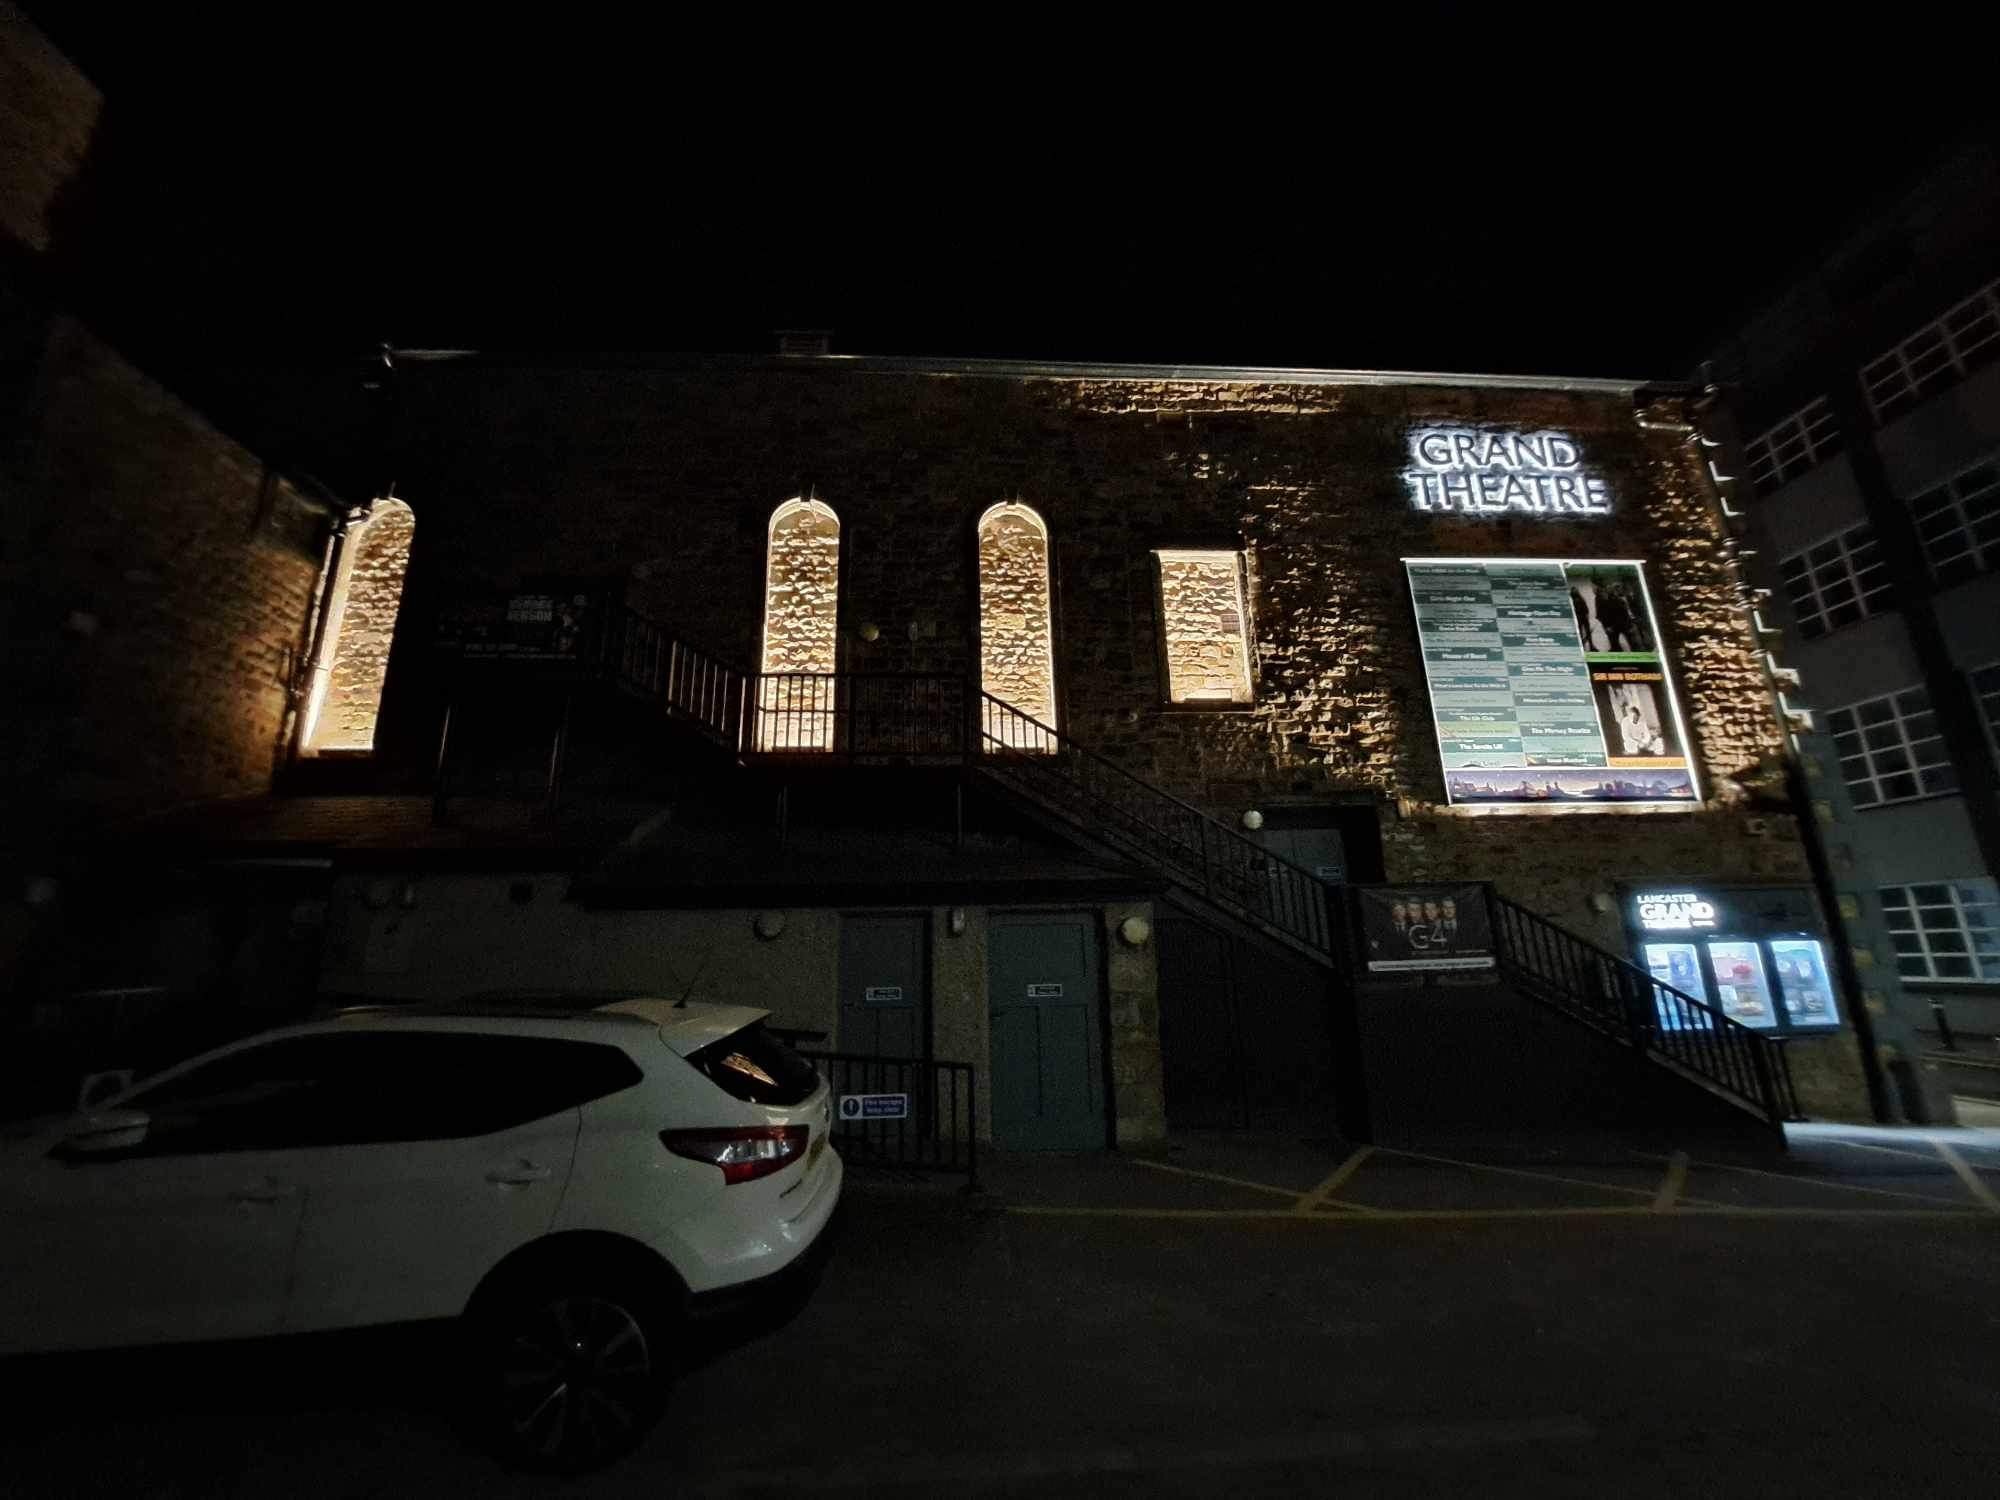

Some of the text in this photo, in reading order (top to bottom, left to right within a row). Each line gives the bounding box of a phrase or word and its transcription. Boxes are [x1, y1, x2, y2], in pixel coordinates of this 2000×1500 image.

[1418, 433, 1580, 467] GRAND
[1409, 473, 1609, 508] THEATRE
[1640, 902, 1715, 920] GRAND
